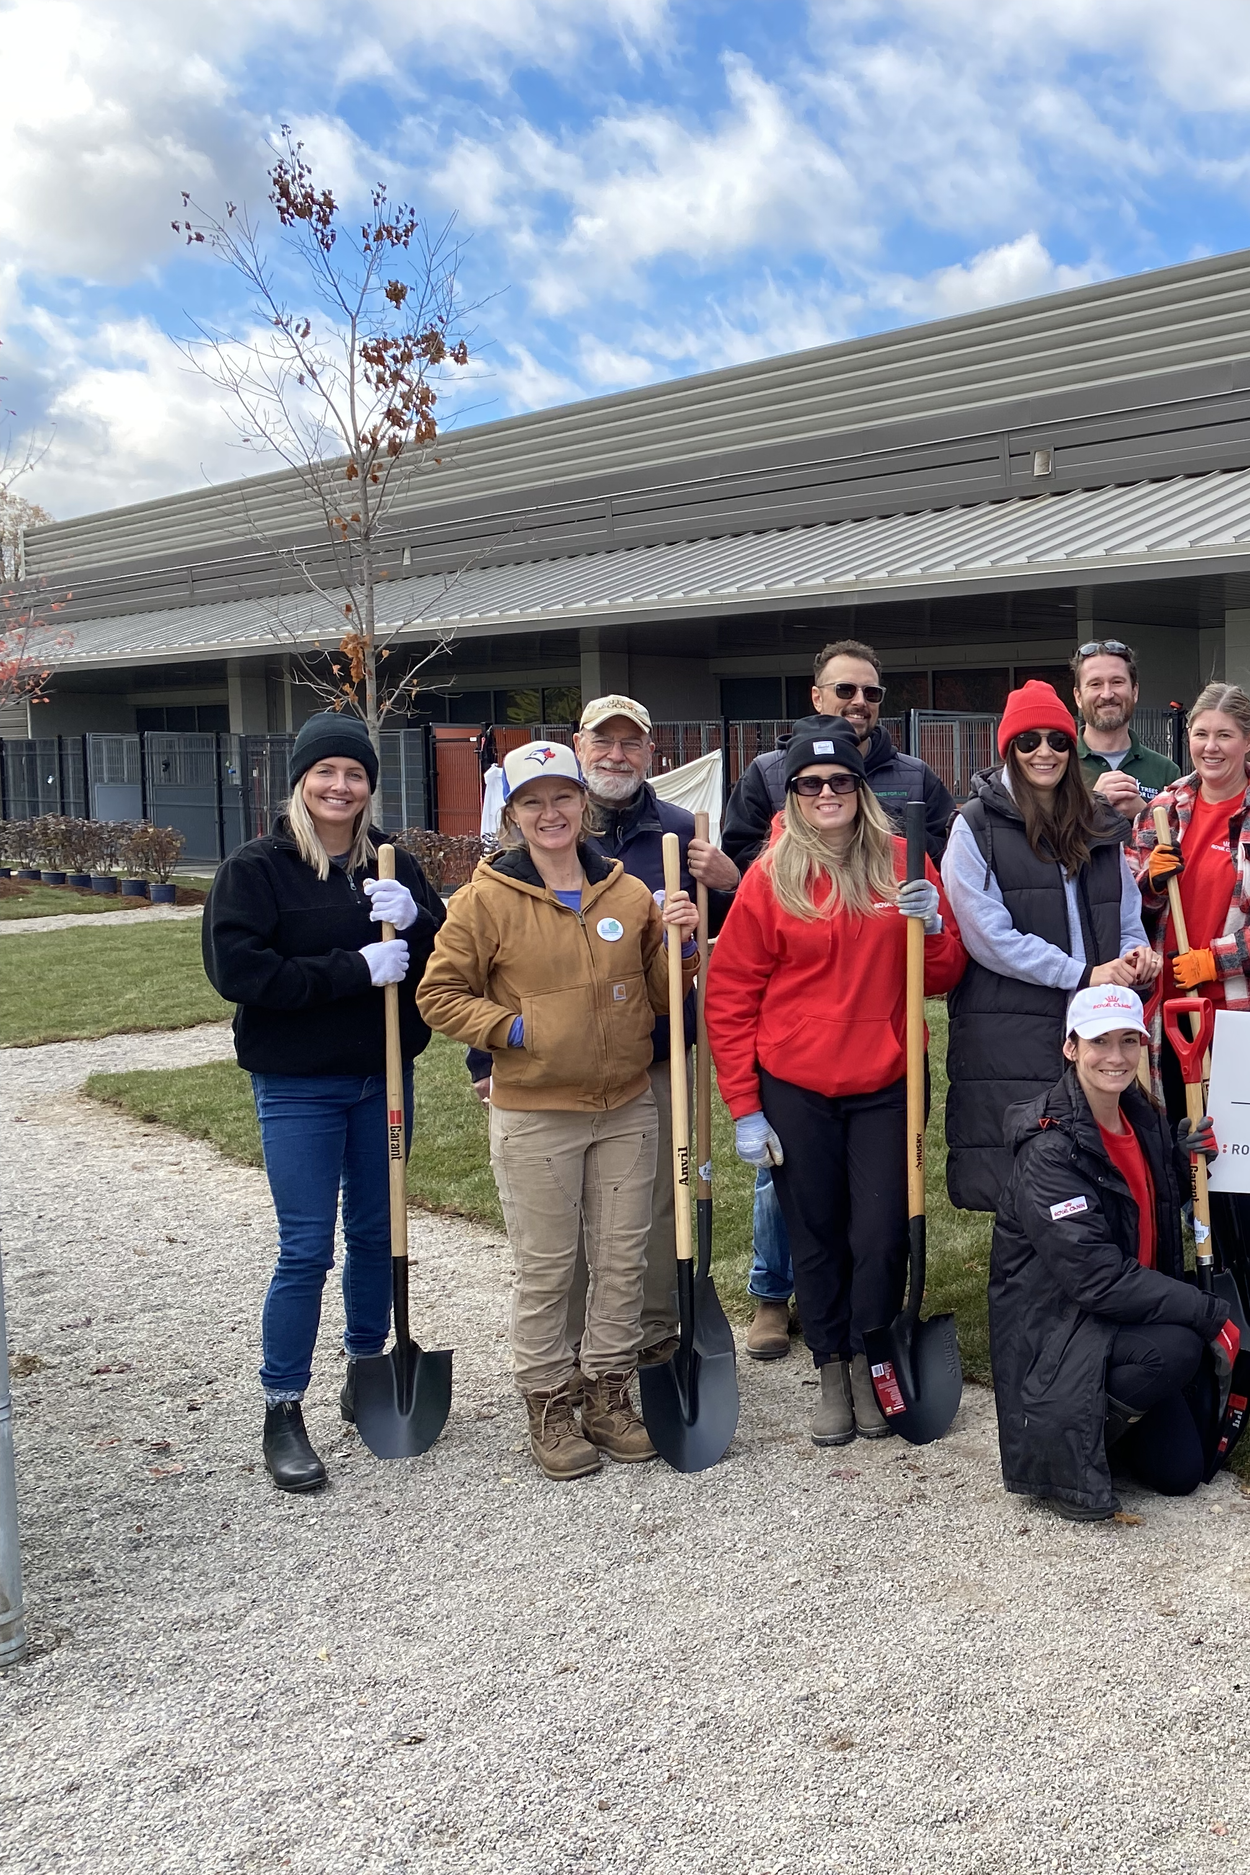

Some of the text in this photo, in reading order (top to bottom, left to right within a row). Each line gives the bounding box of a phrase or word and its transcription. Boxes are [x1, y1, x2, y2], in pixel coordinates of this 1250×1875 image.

[390, 1125, 402, 1161] Garant
[678, 1146, 689, 1187] Anvil
[1190, 1165, 1200, 1203] Garant
